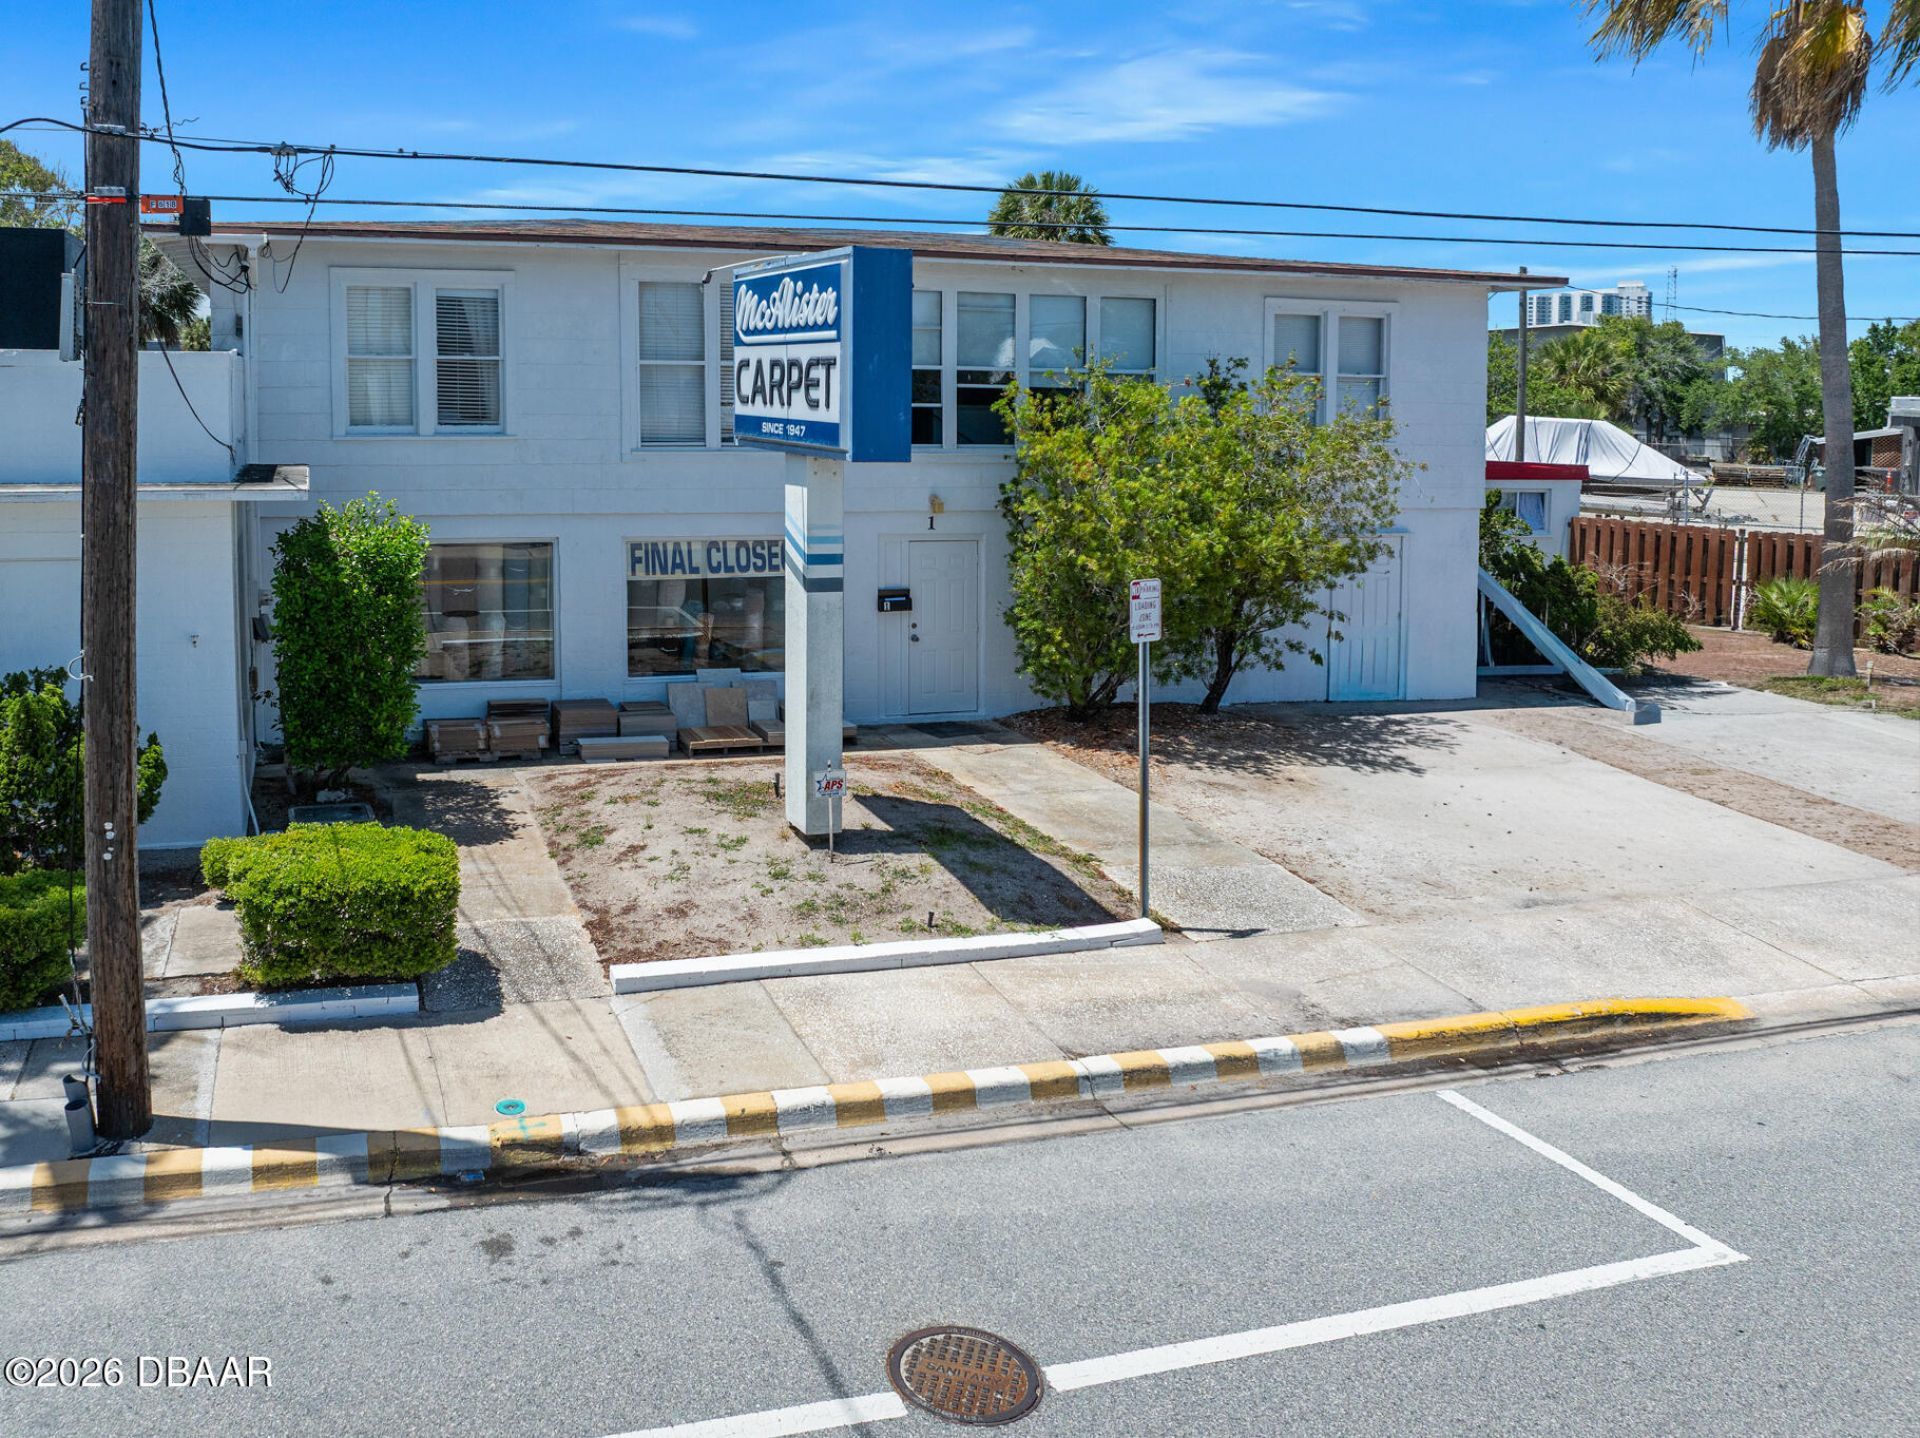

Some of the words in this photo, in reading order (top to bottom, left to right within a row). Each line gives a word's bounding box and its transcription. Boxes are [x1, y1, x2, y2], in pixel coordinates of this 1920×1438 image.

[736, 277, 838, 331] McAlister
[737, 358, 836, 410] CARPET
[762, 422, 784, 435] SINCE
[786, 424, 806, 437] 1947
[928, 515, 936, 530] 1
[630, 542, 700, 576] FINAL
[1134, 600, 1156, 610] LOADING
[824, 779, 844, 791] APS
[926, 1362, 1002, 1385] SANITARY
